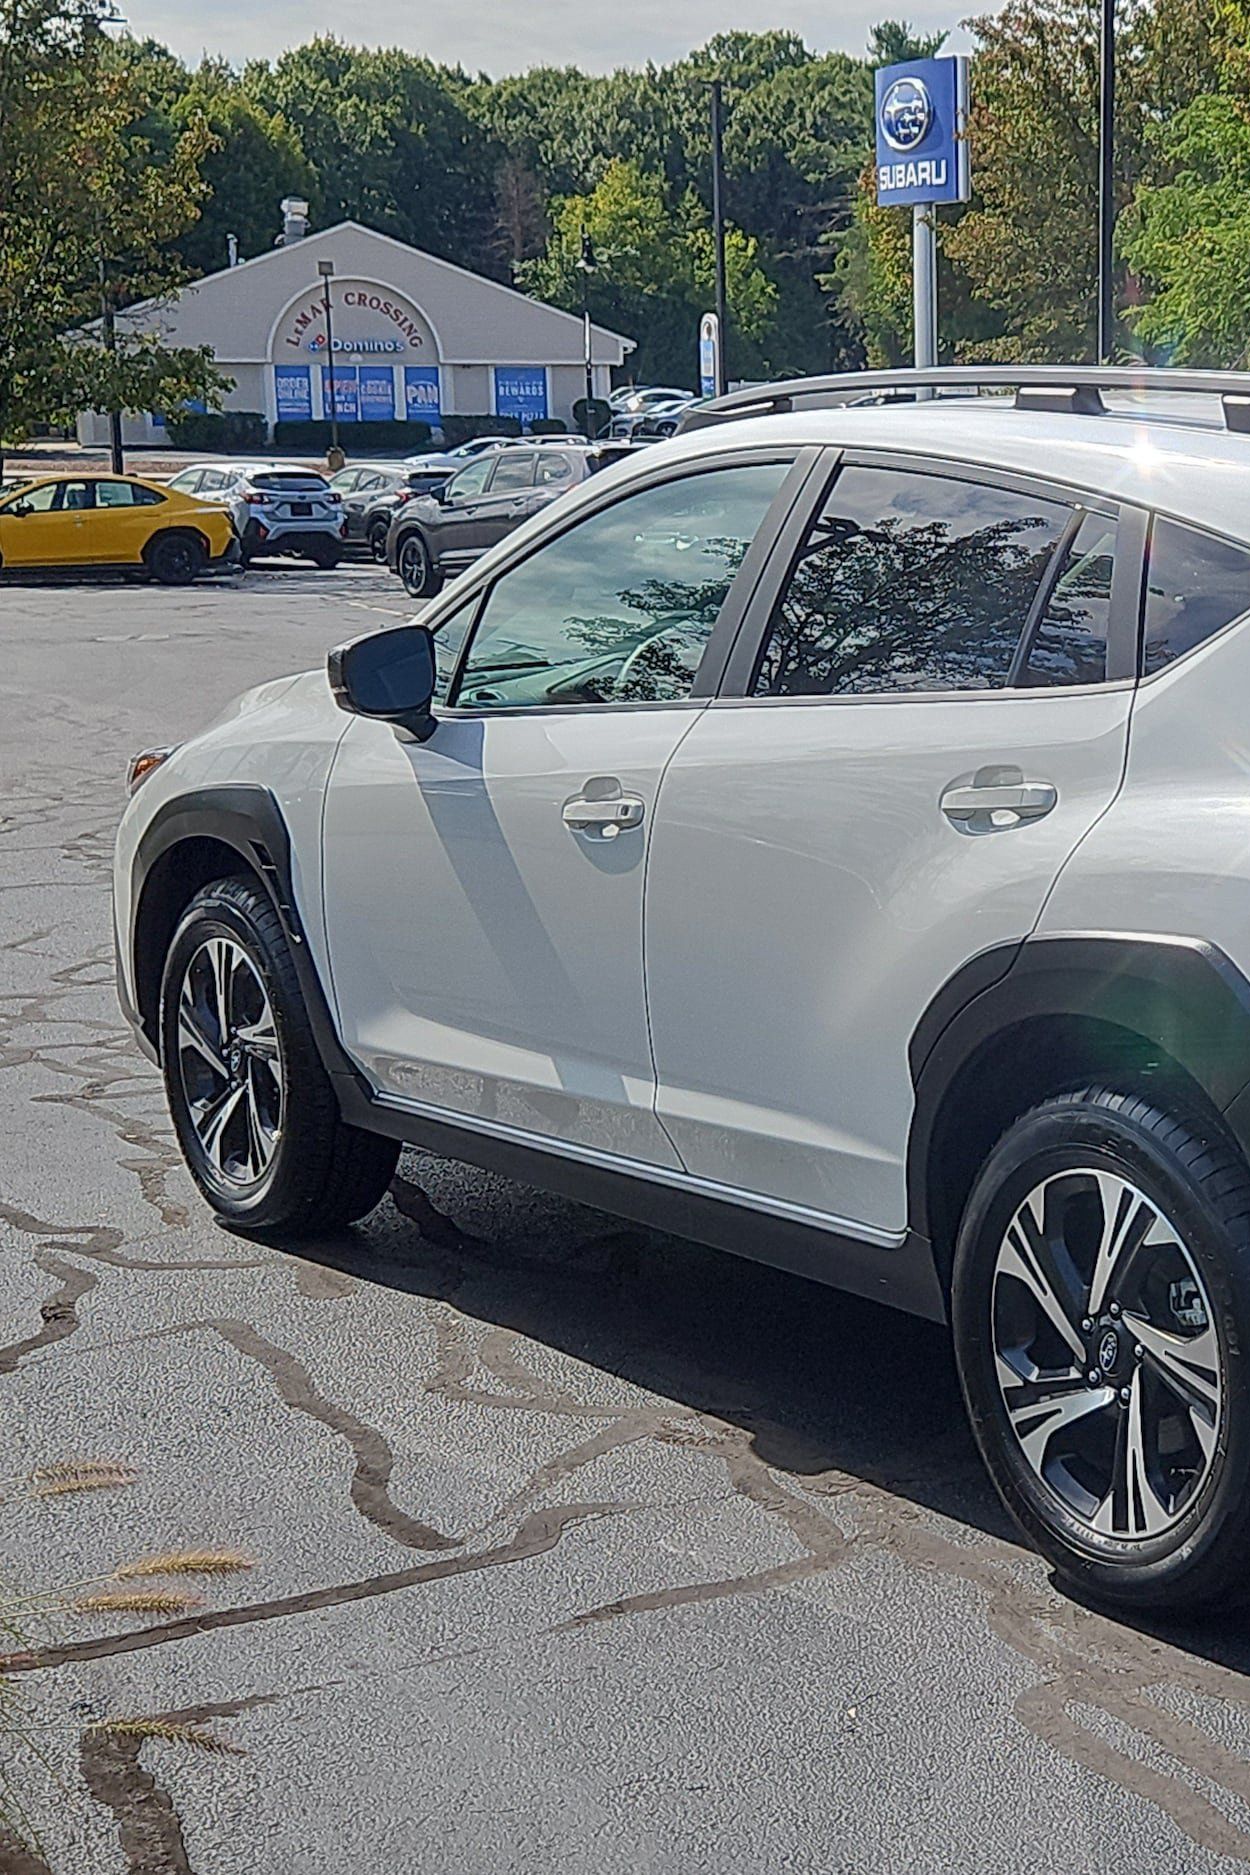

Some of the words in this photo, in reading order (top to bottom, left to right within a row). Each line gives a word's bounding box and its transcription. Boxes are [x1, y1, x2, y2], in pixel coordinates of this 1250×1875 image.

[879, 159, 947, 191] SUBARU
[343, 291, 423, 348] CROSSING
[499, 386, 545, 396] REWARDS
